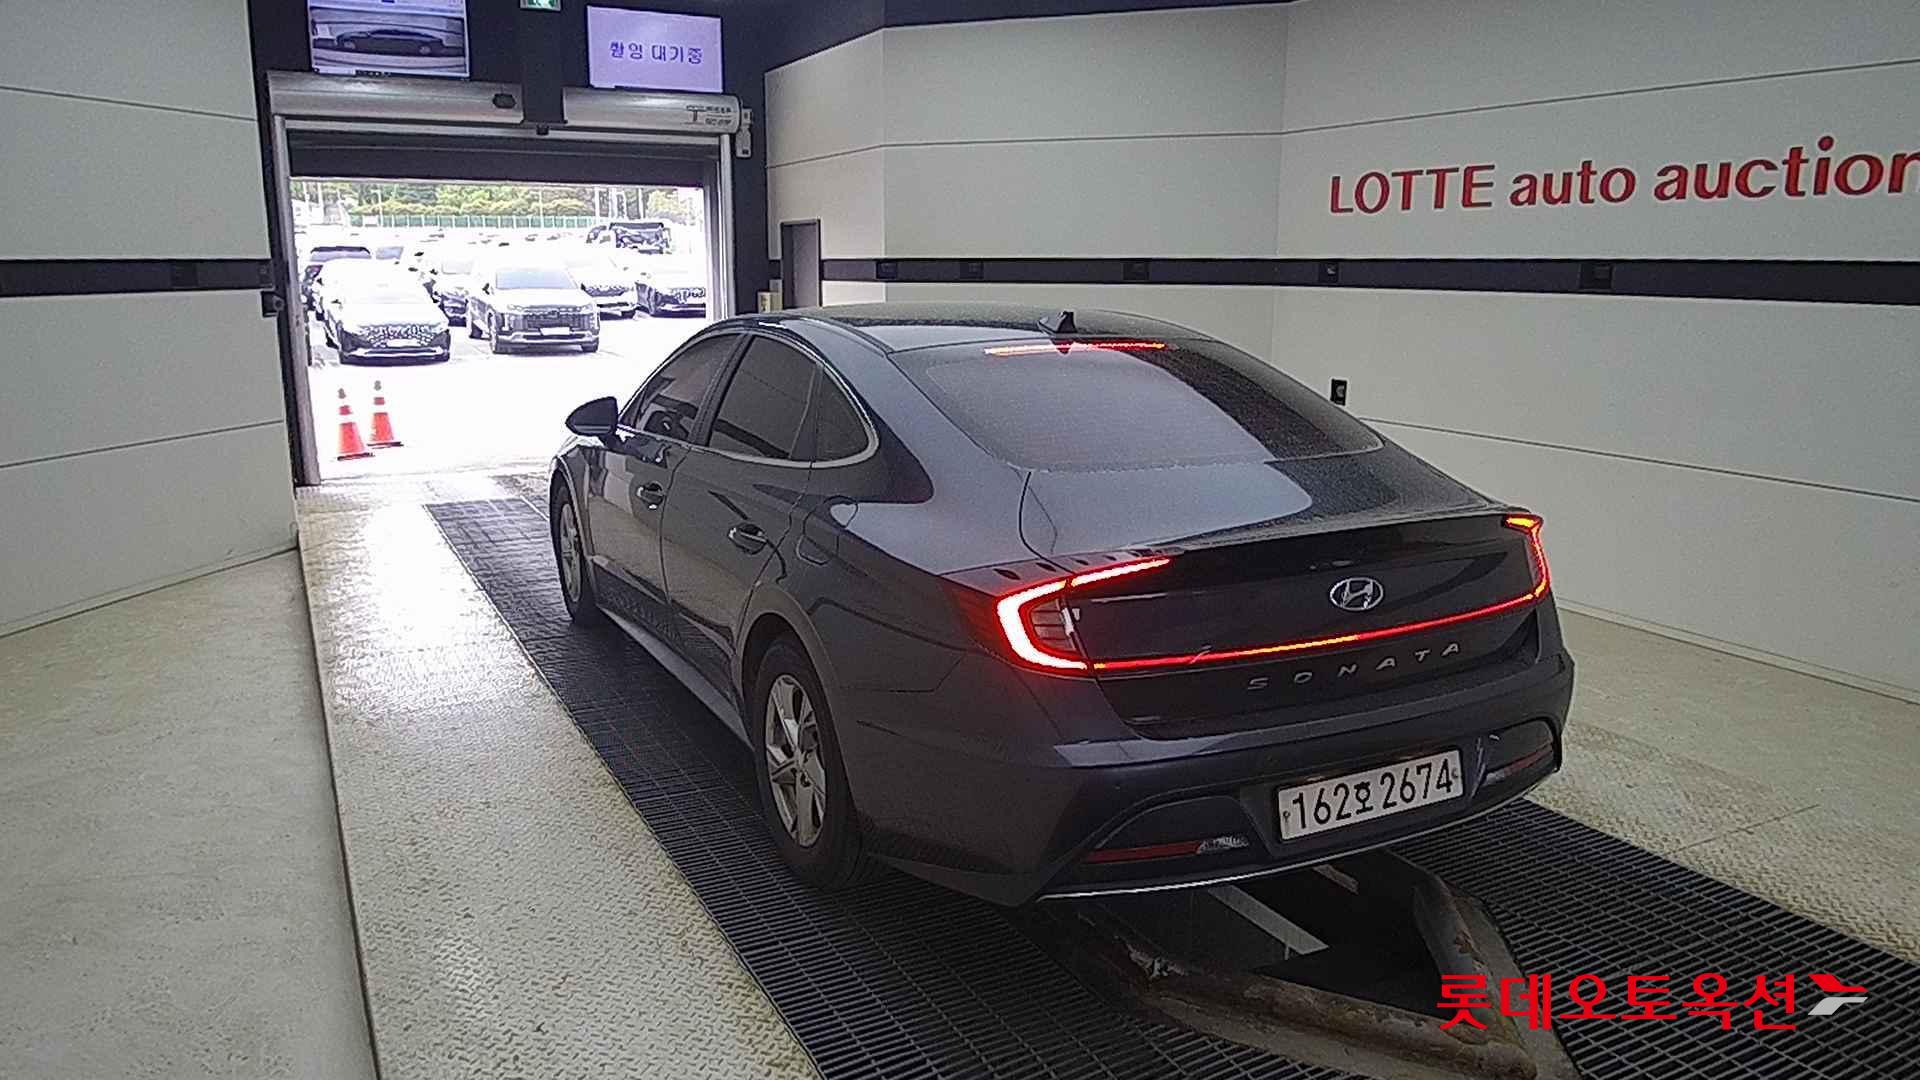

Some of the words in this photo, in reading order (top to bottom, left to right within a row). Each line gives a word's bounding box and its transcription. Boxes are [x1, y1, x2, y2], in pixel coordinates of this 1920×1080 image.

[1330, 164, 1495, 214] LOTTE
[1510, 160, 1636, 206] auto
[1247, 642, 1460, 691] SONATA
